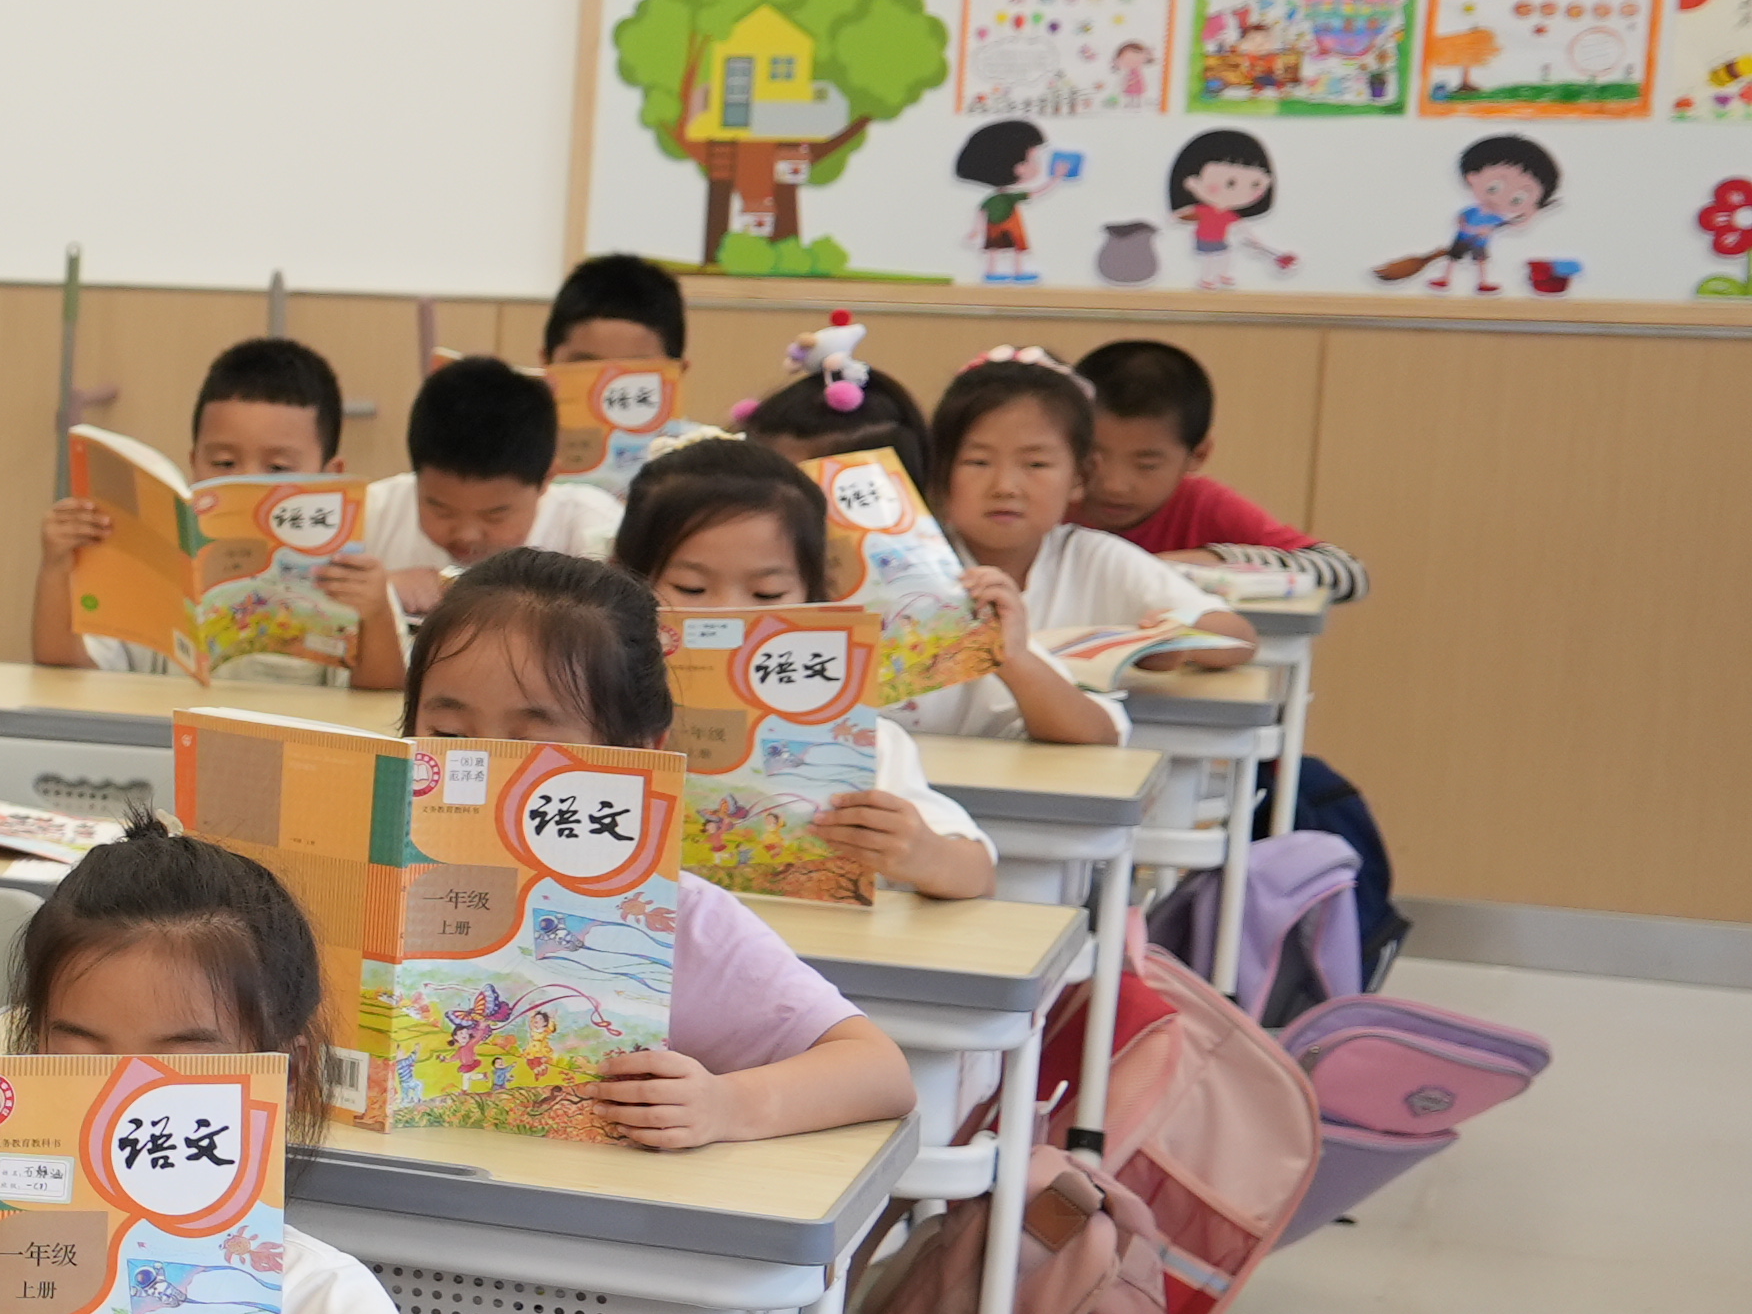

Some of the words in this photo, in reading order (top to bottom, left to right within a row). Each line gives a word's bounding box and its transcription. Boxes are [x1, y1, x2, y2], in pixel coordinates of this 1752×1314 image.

[605, 387, 661, 411] 语文
[272, 506, 338, 530] 语文
[755, 650, 841, 684] 语文
[529, 795, 635, 841] 语文
[423, 888, 491, 912] 一年级
[439, 920, 472, 937] 上册
[118, 1116, 235, 1170] 语文
[15, 1280, 58, 1300] 上册
